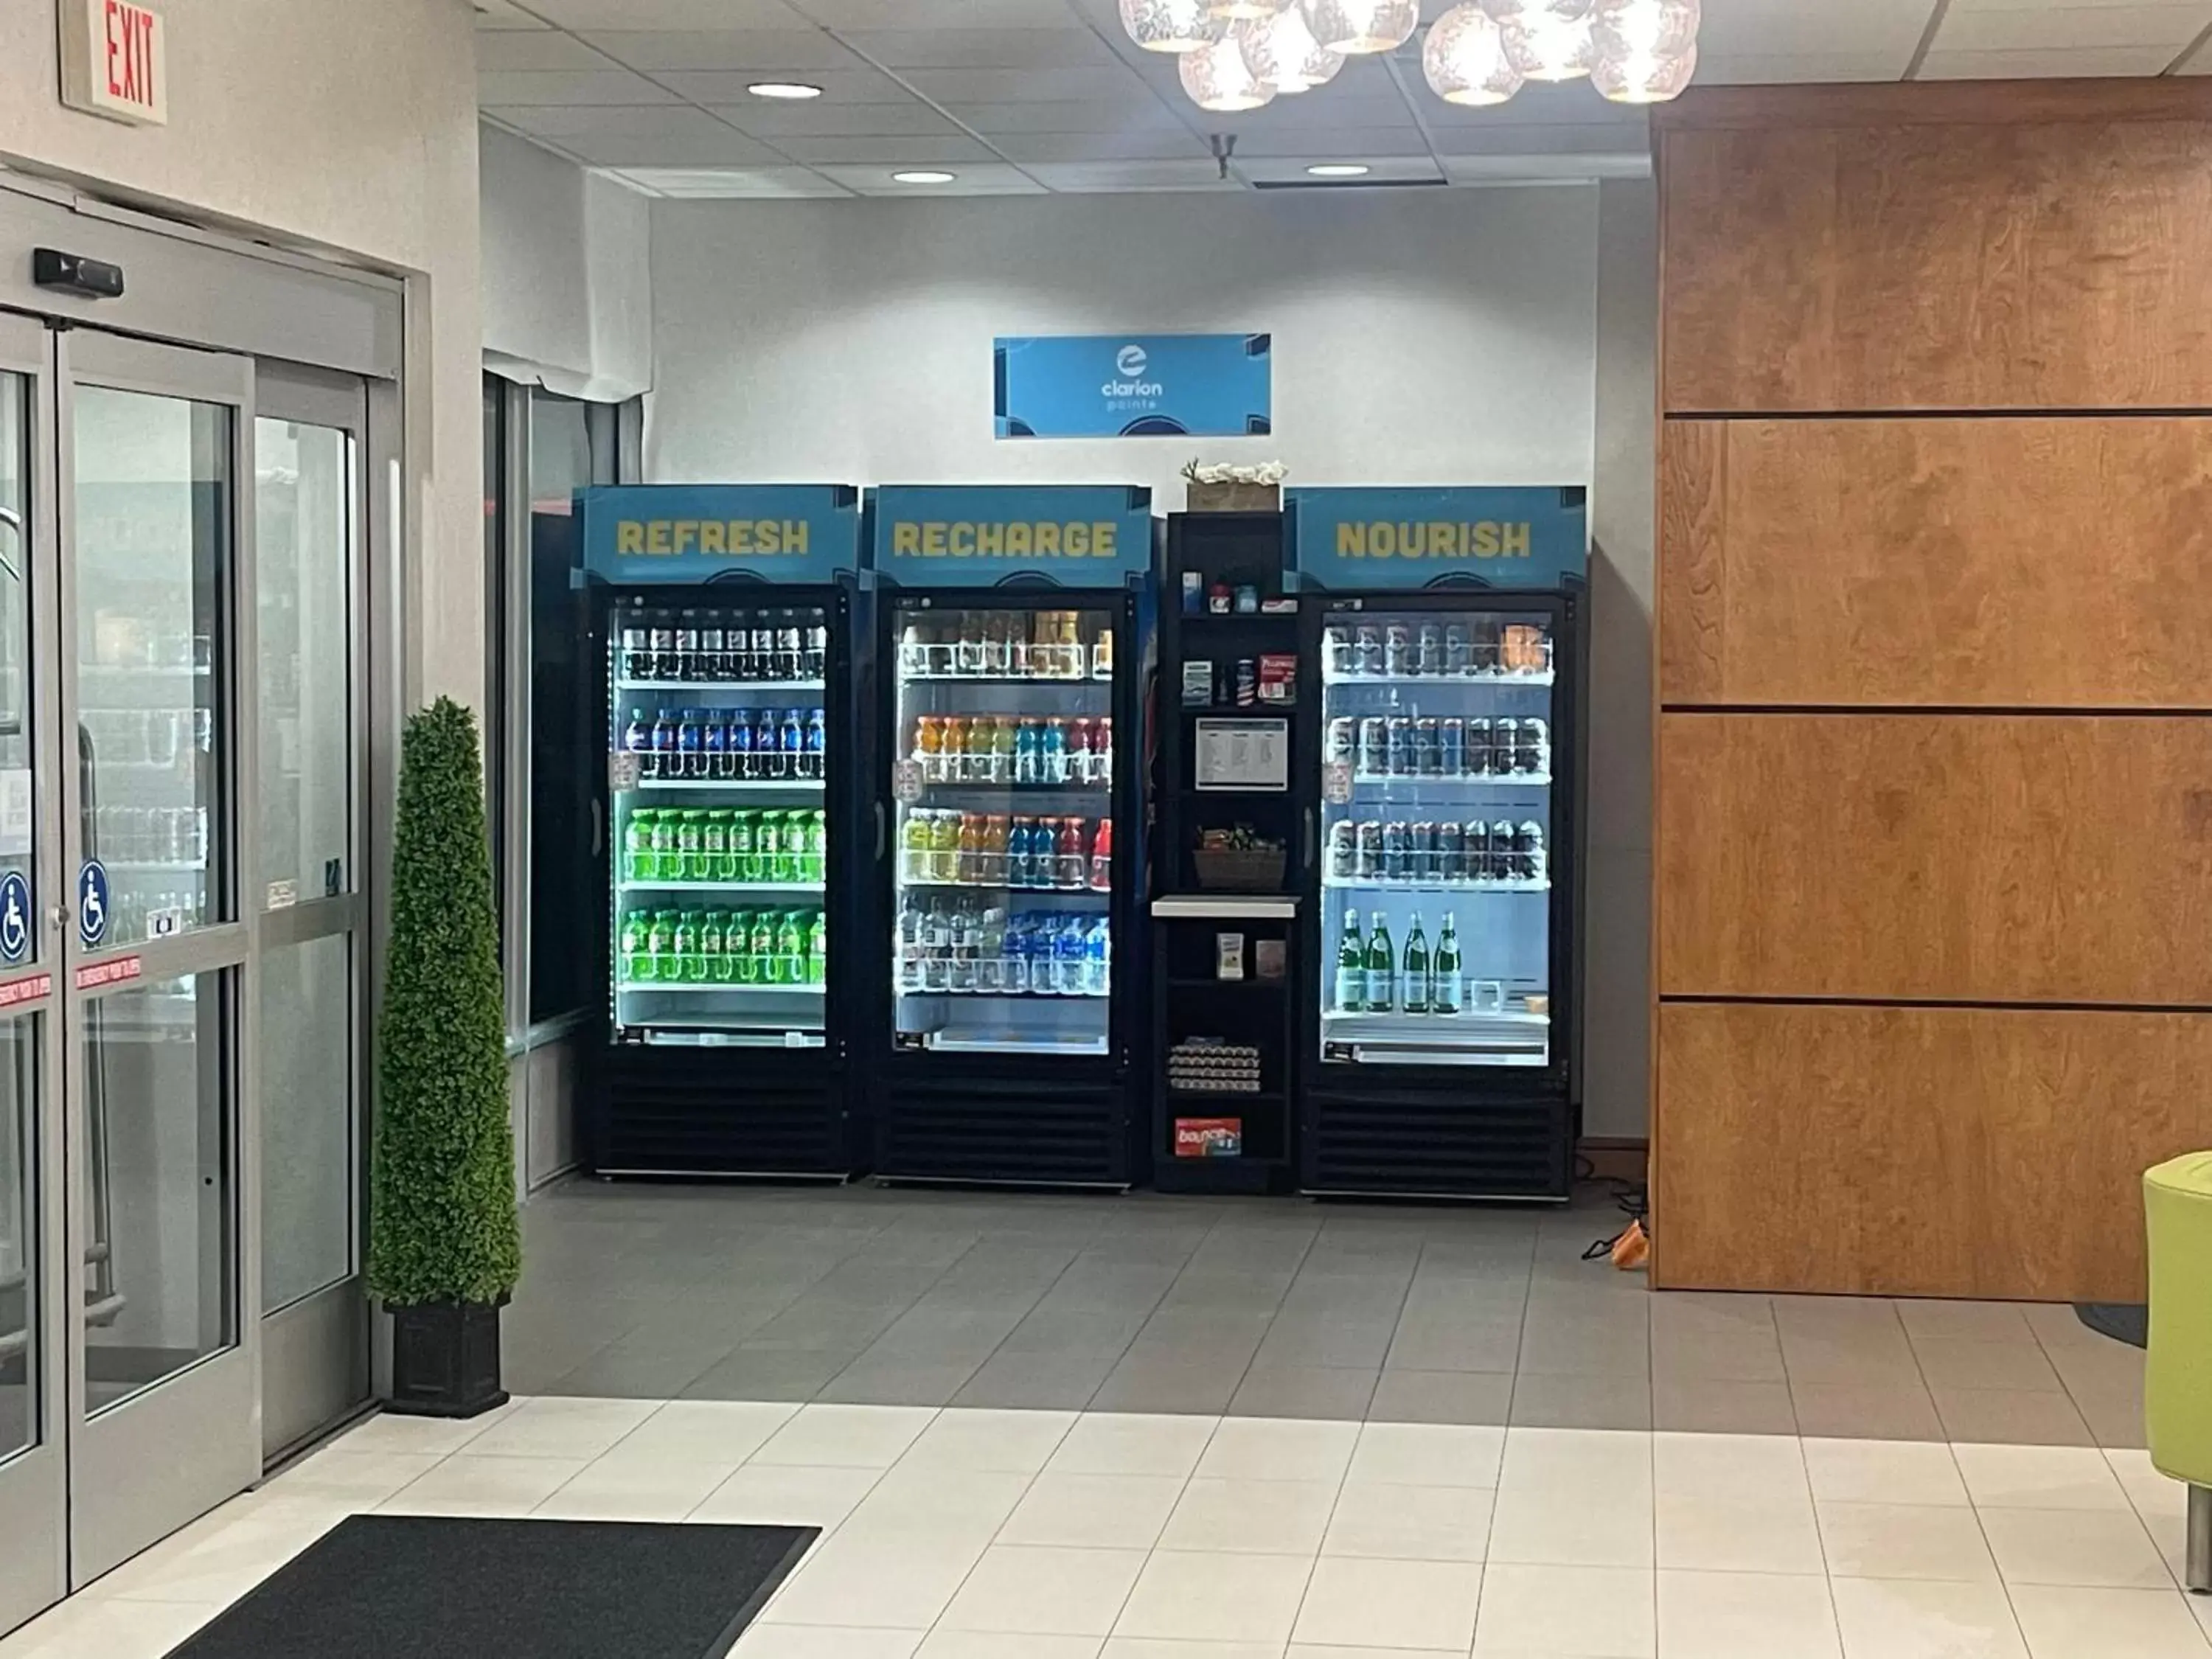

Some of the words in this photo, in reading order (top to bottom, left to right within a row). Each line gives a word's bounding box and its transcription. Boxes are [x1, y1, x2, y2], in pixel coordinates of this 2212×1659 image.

[106, 0, 153, 106] EXIT
[1102, 379, 1163, 396] clarion
[618, 520, 808, 555] REFRESH
[894, 521, 1117, 557] RECHARGE
[1337, 521, 1531, 558] NOURISH
